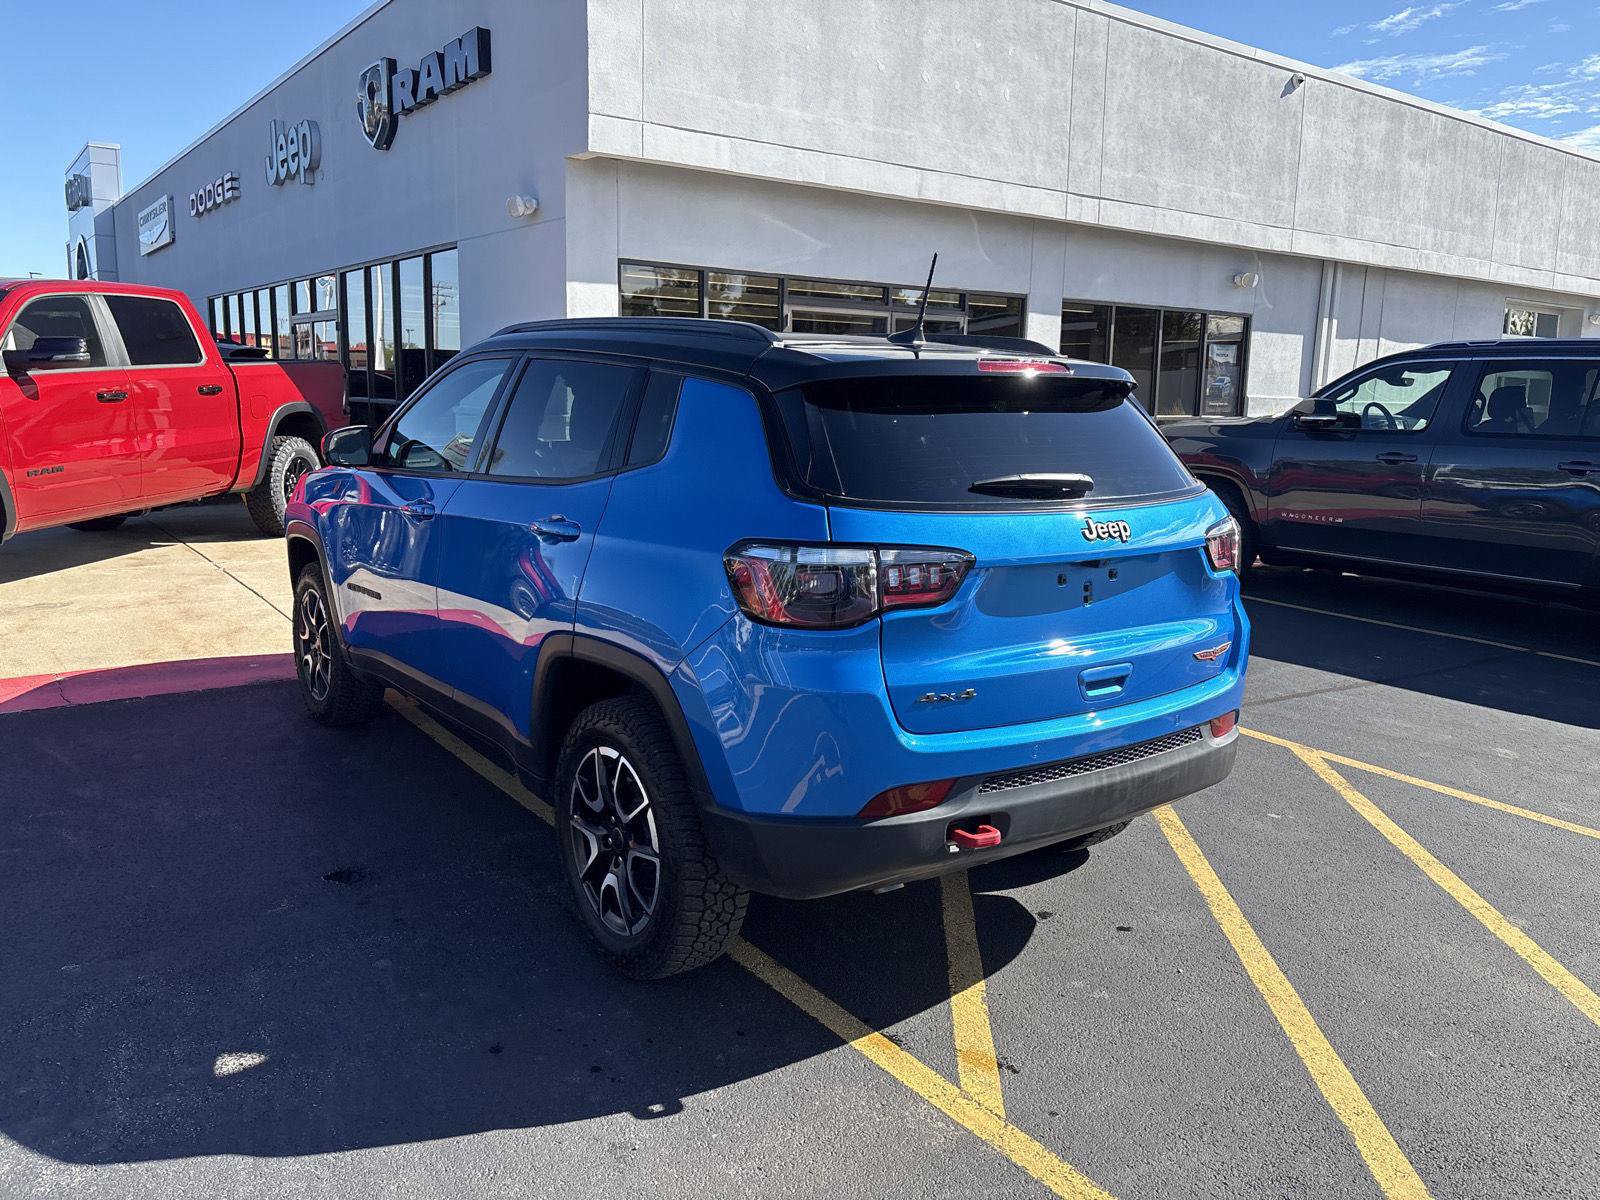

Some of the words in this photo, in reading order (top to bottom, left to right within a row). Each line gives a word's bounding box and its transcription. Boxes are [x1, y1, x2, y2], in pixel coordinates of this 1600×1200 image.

[392, 26, 491, 116] RAM
[265, 119, 321, 187] Jeep
[190, 171, 240, 218] DODGE
[139, 201, 167, 227] CHRYSLER
[27, 466, 64, 477] RAM
[1080, 516, 1131, 543] Jeep
[1281, 512, 1333, 521] WAGONEER
